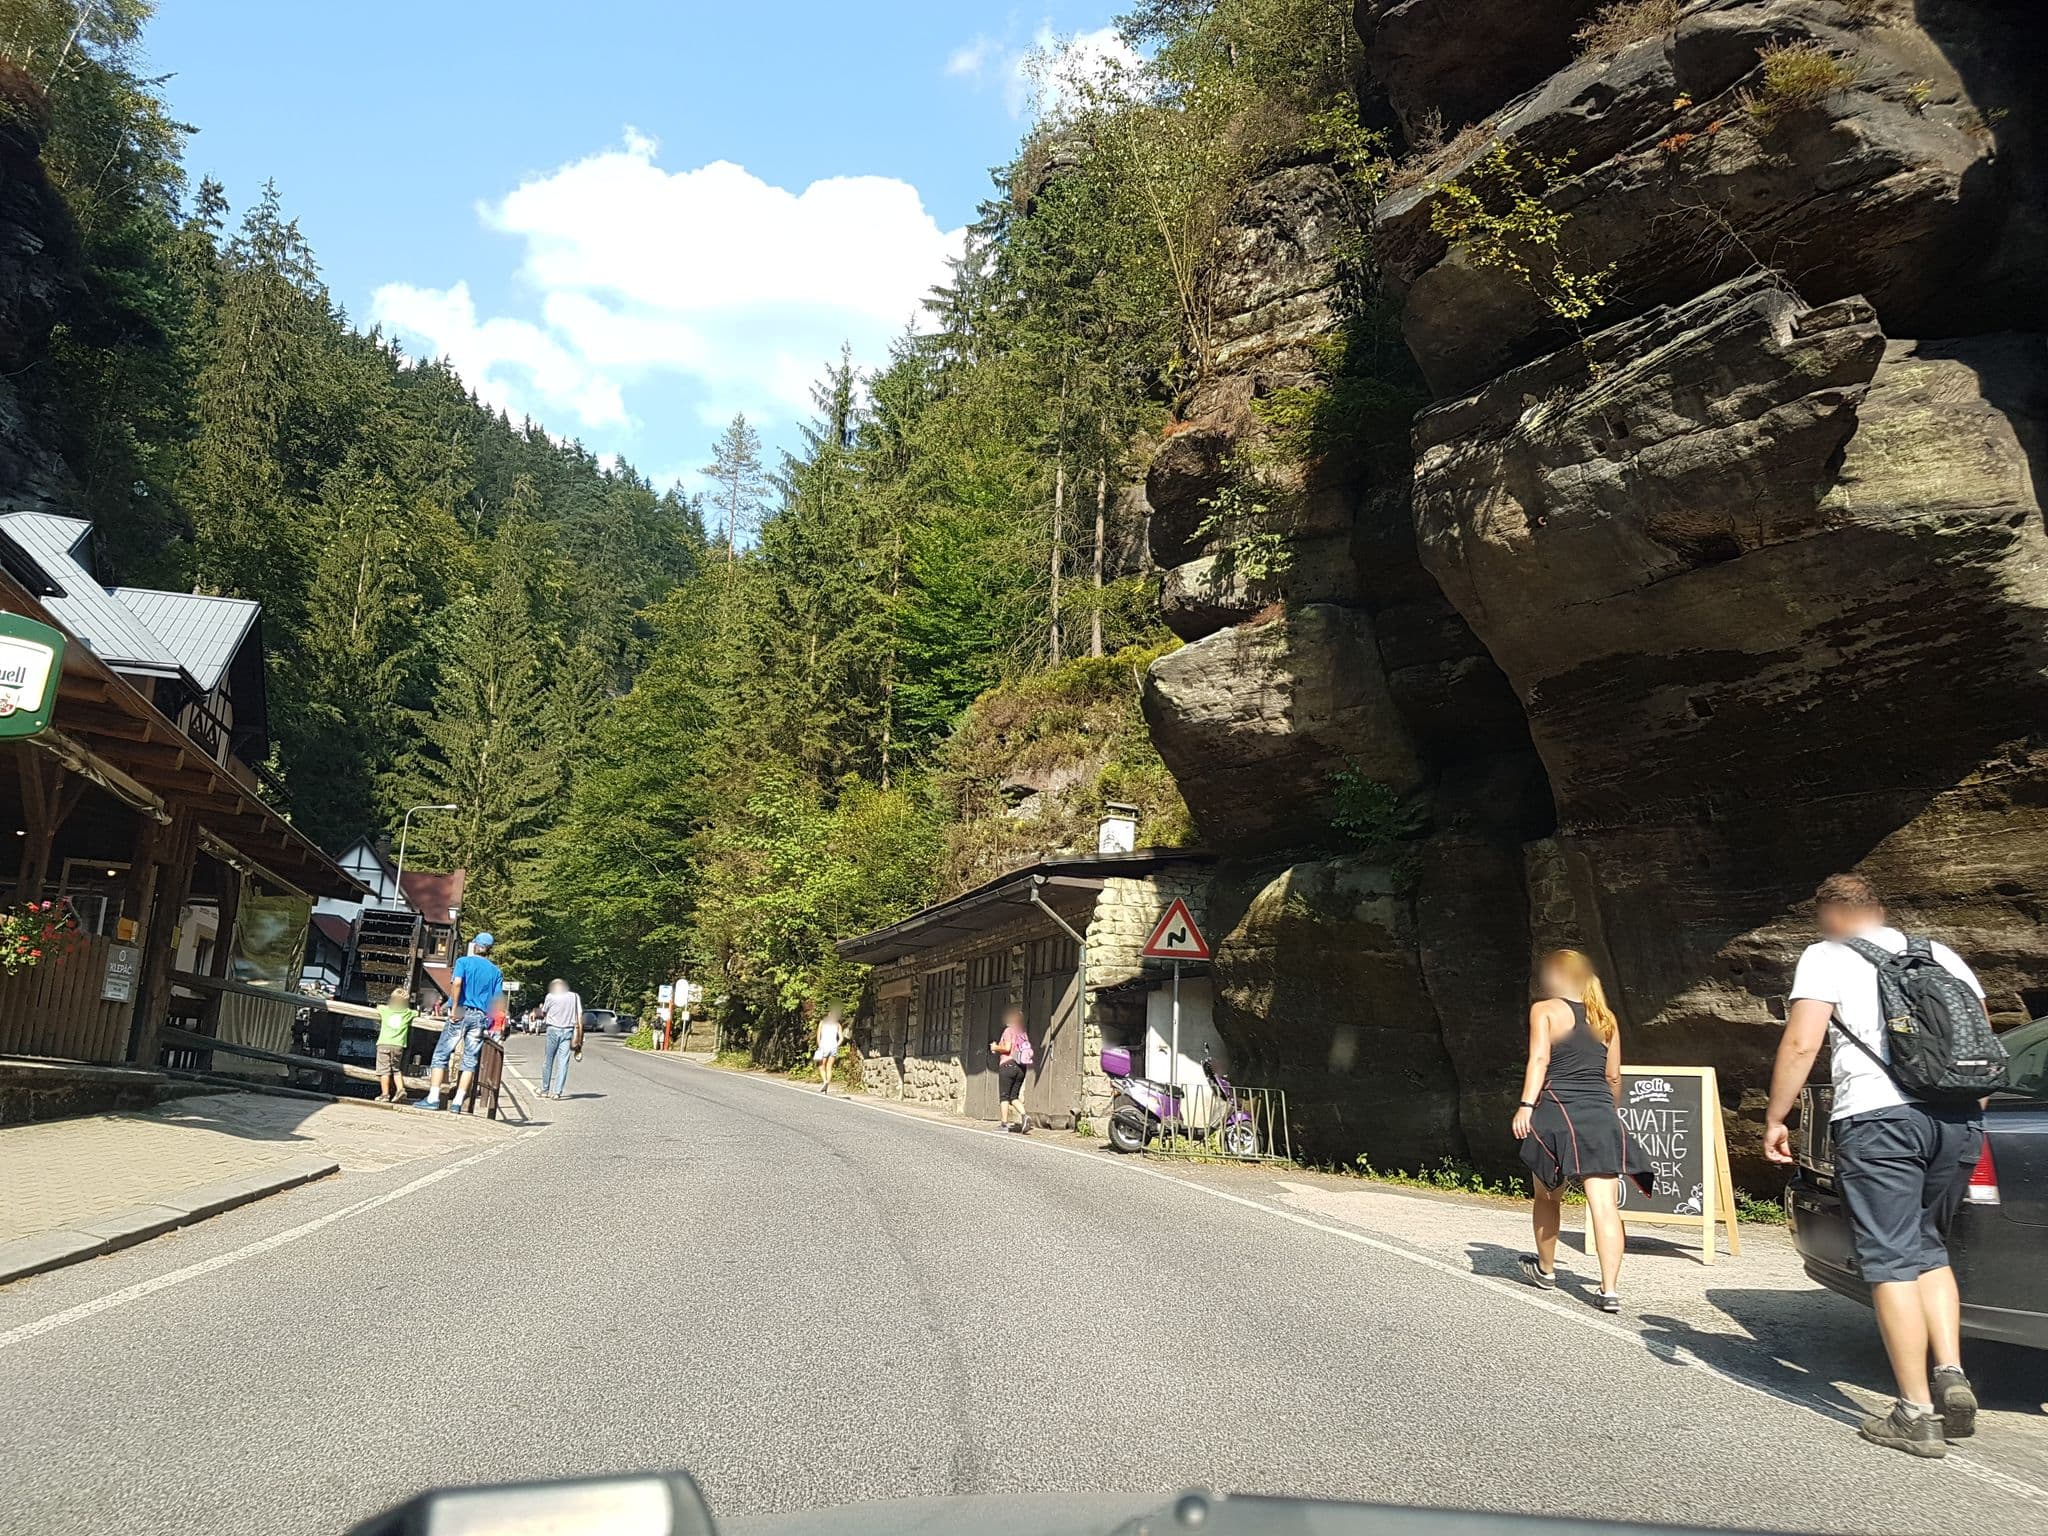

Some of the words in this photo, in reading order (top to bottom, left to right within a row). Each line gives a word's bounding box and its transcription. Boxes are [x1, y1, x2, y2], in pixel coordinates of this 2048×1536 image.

[0, 666, 26, 684] uell
[1617, 1107, 1688, 1133] RIVATE
[1629, 1132, 1688, 1159] KING
[1650, 1161, 1684, 1178] SEK
